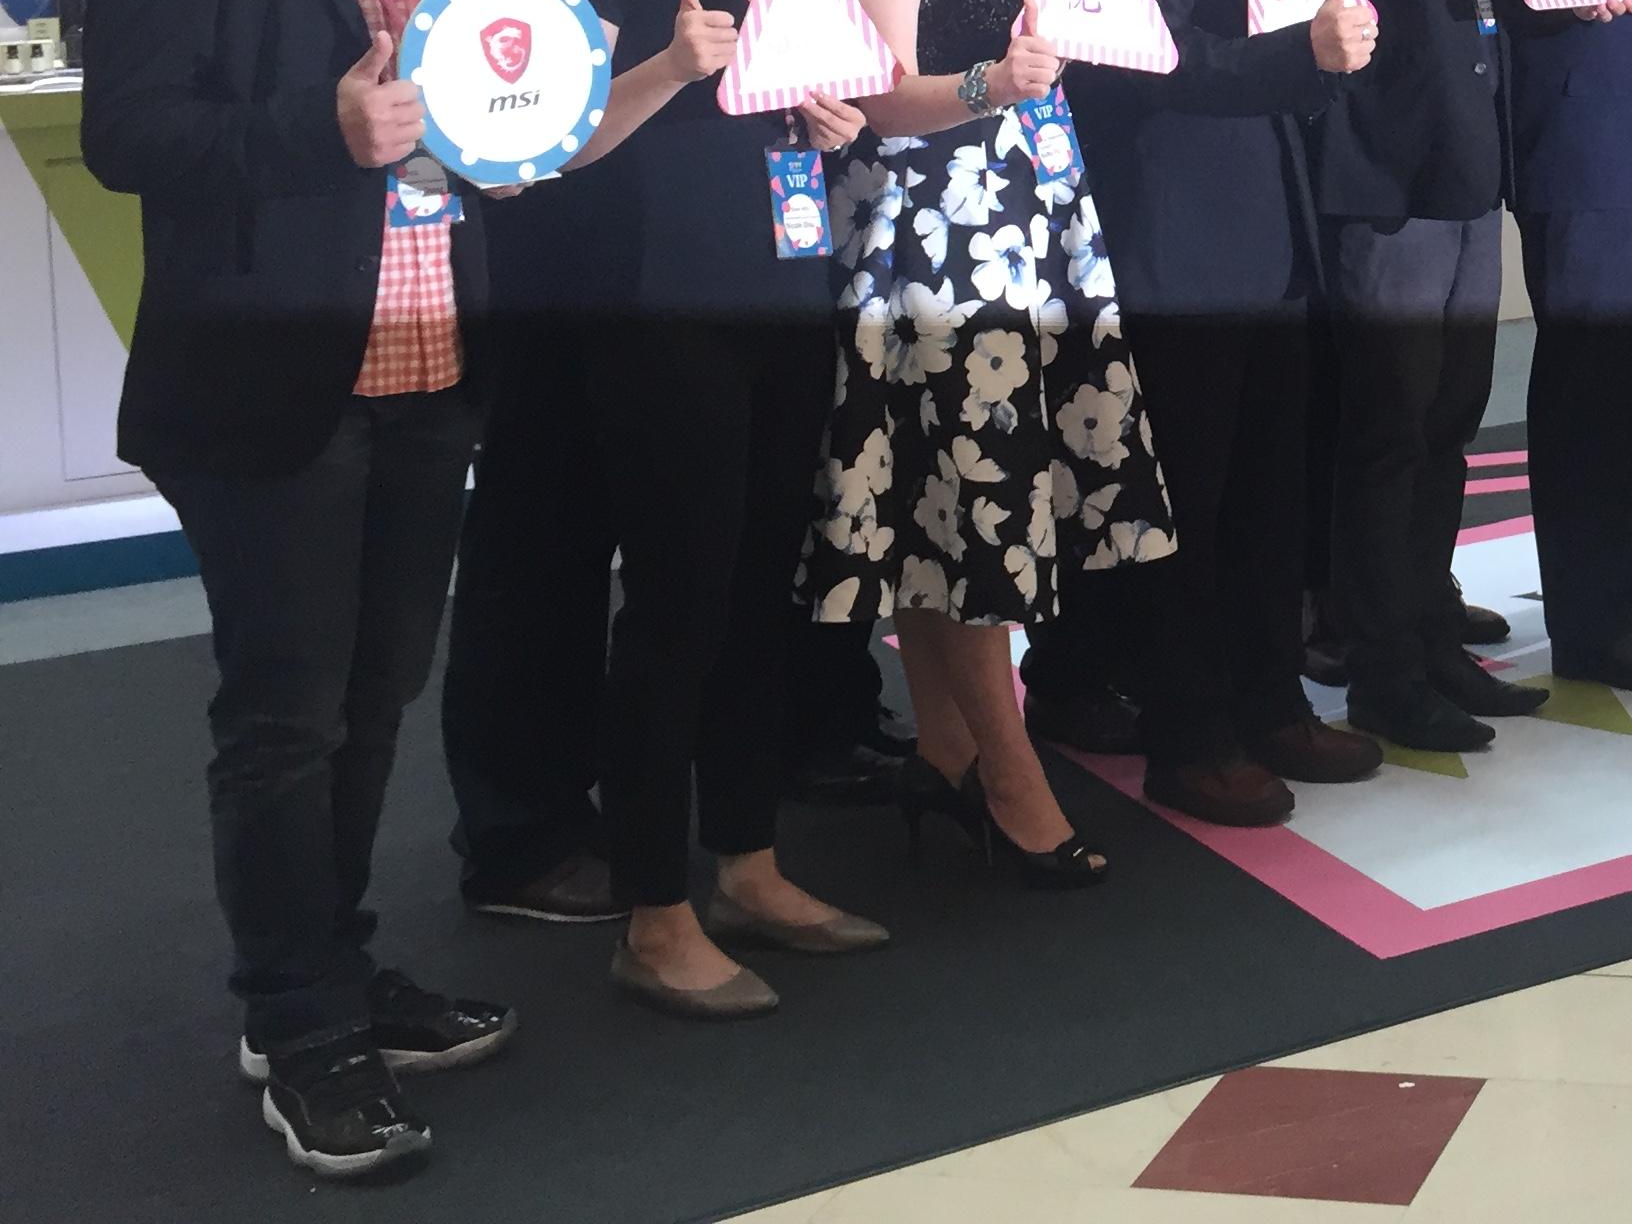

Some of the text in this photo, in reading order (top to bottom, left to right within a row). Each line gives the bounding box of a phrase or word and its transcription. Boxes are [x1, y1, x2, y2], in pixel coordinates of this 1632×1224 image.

[488, 88, 541, 114] msi
[1034, 104, 1054, 121] VIP
[786, 174, 809, 189] VIP
